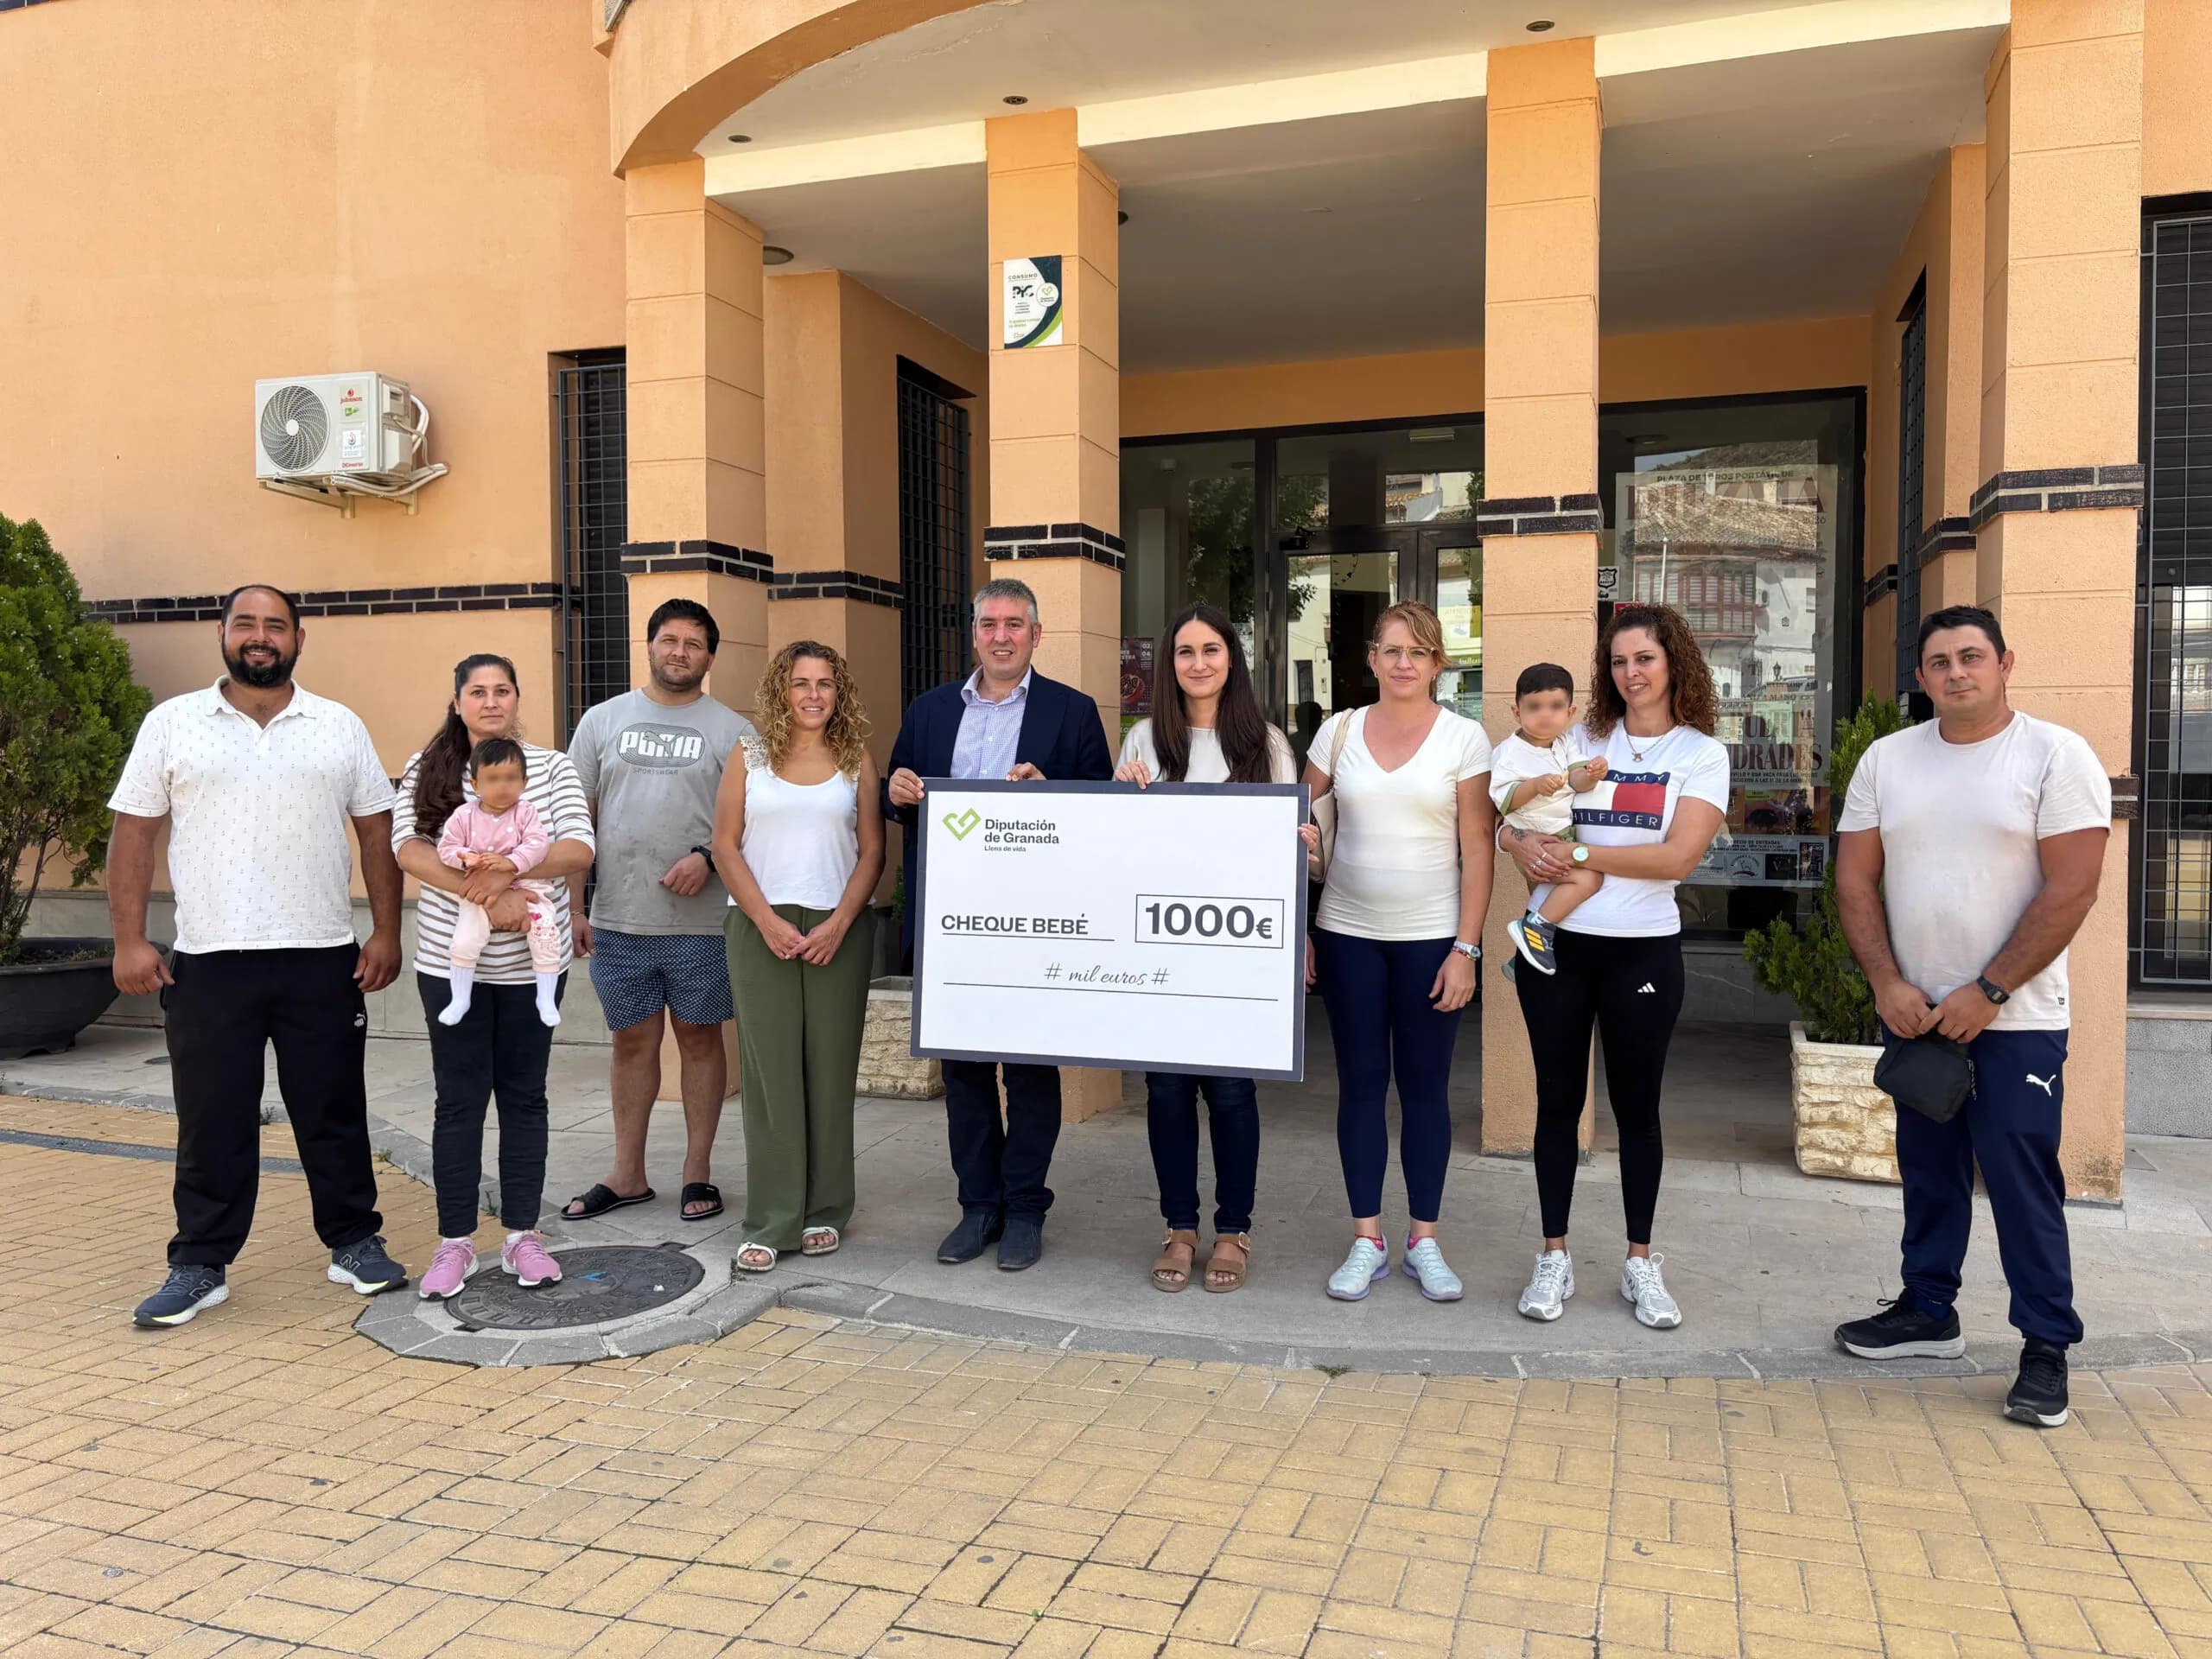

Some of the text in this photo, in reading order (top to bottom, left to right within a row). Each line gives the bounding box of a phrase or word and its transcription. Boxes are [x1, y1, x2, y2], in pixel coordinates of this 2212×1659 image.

[1613, 773, 1665, 782] MMY
[985, 818, 1056, 832] Diputación
[984, 831, 1059, 844] de Granada
[941, 912, 1089, 936] CHEQUE BEBÉ
[1146, 902, 1273, 940] 1000€
[1069, 964, 1096, 984] mil
[1100, 969, 1147, 987] euros
